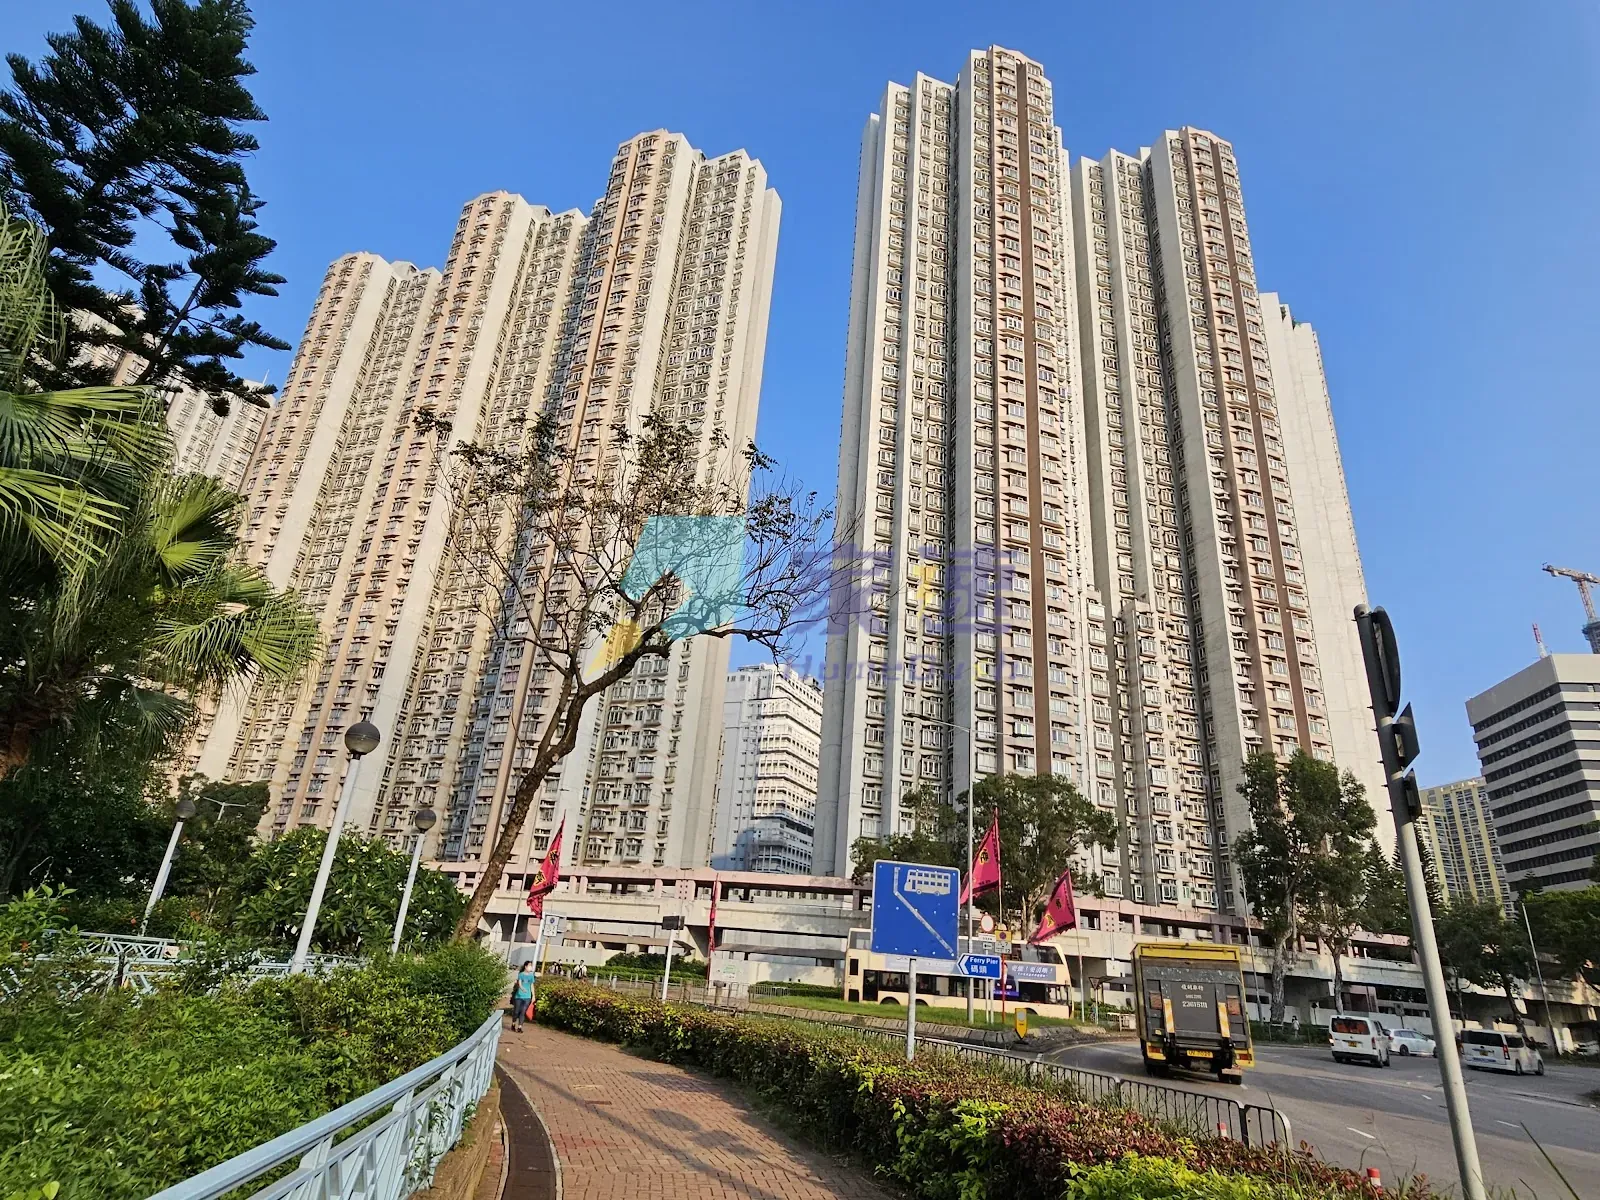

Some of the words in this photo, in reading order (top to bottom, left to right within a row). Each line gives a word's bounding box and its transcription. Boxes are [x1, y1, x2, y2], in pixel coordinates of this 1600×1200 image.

[969, 956, 985, 965] Ferry
[986, 957, 998, 965] Pier
[970, 964, 987, 973] 碼頭
